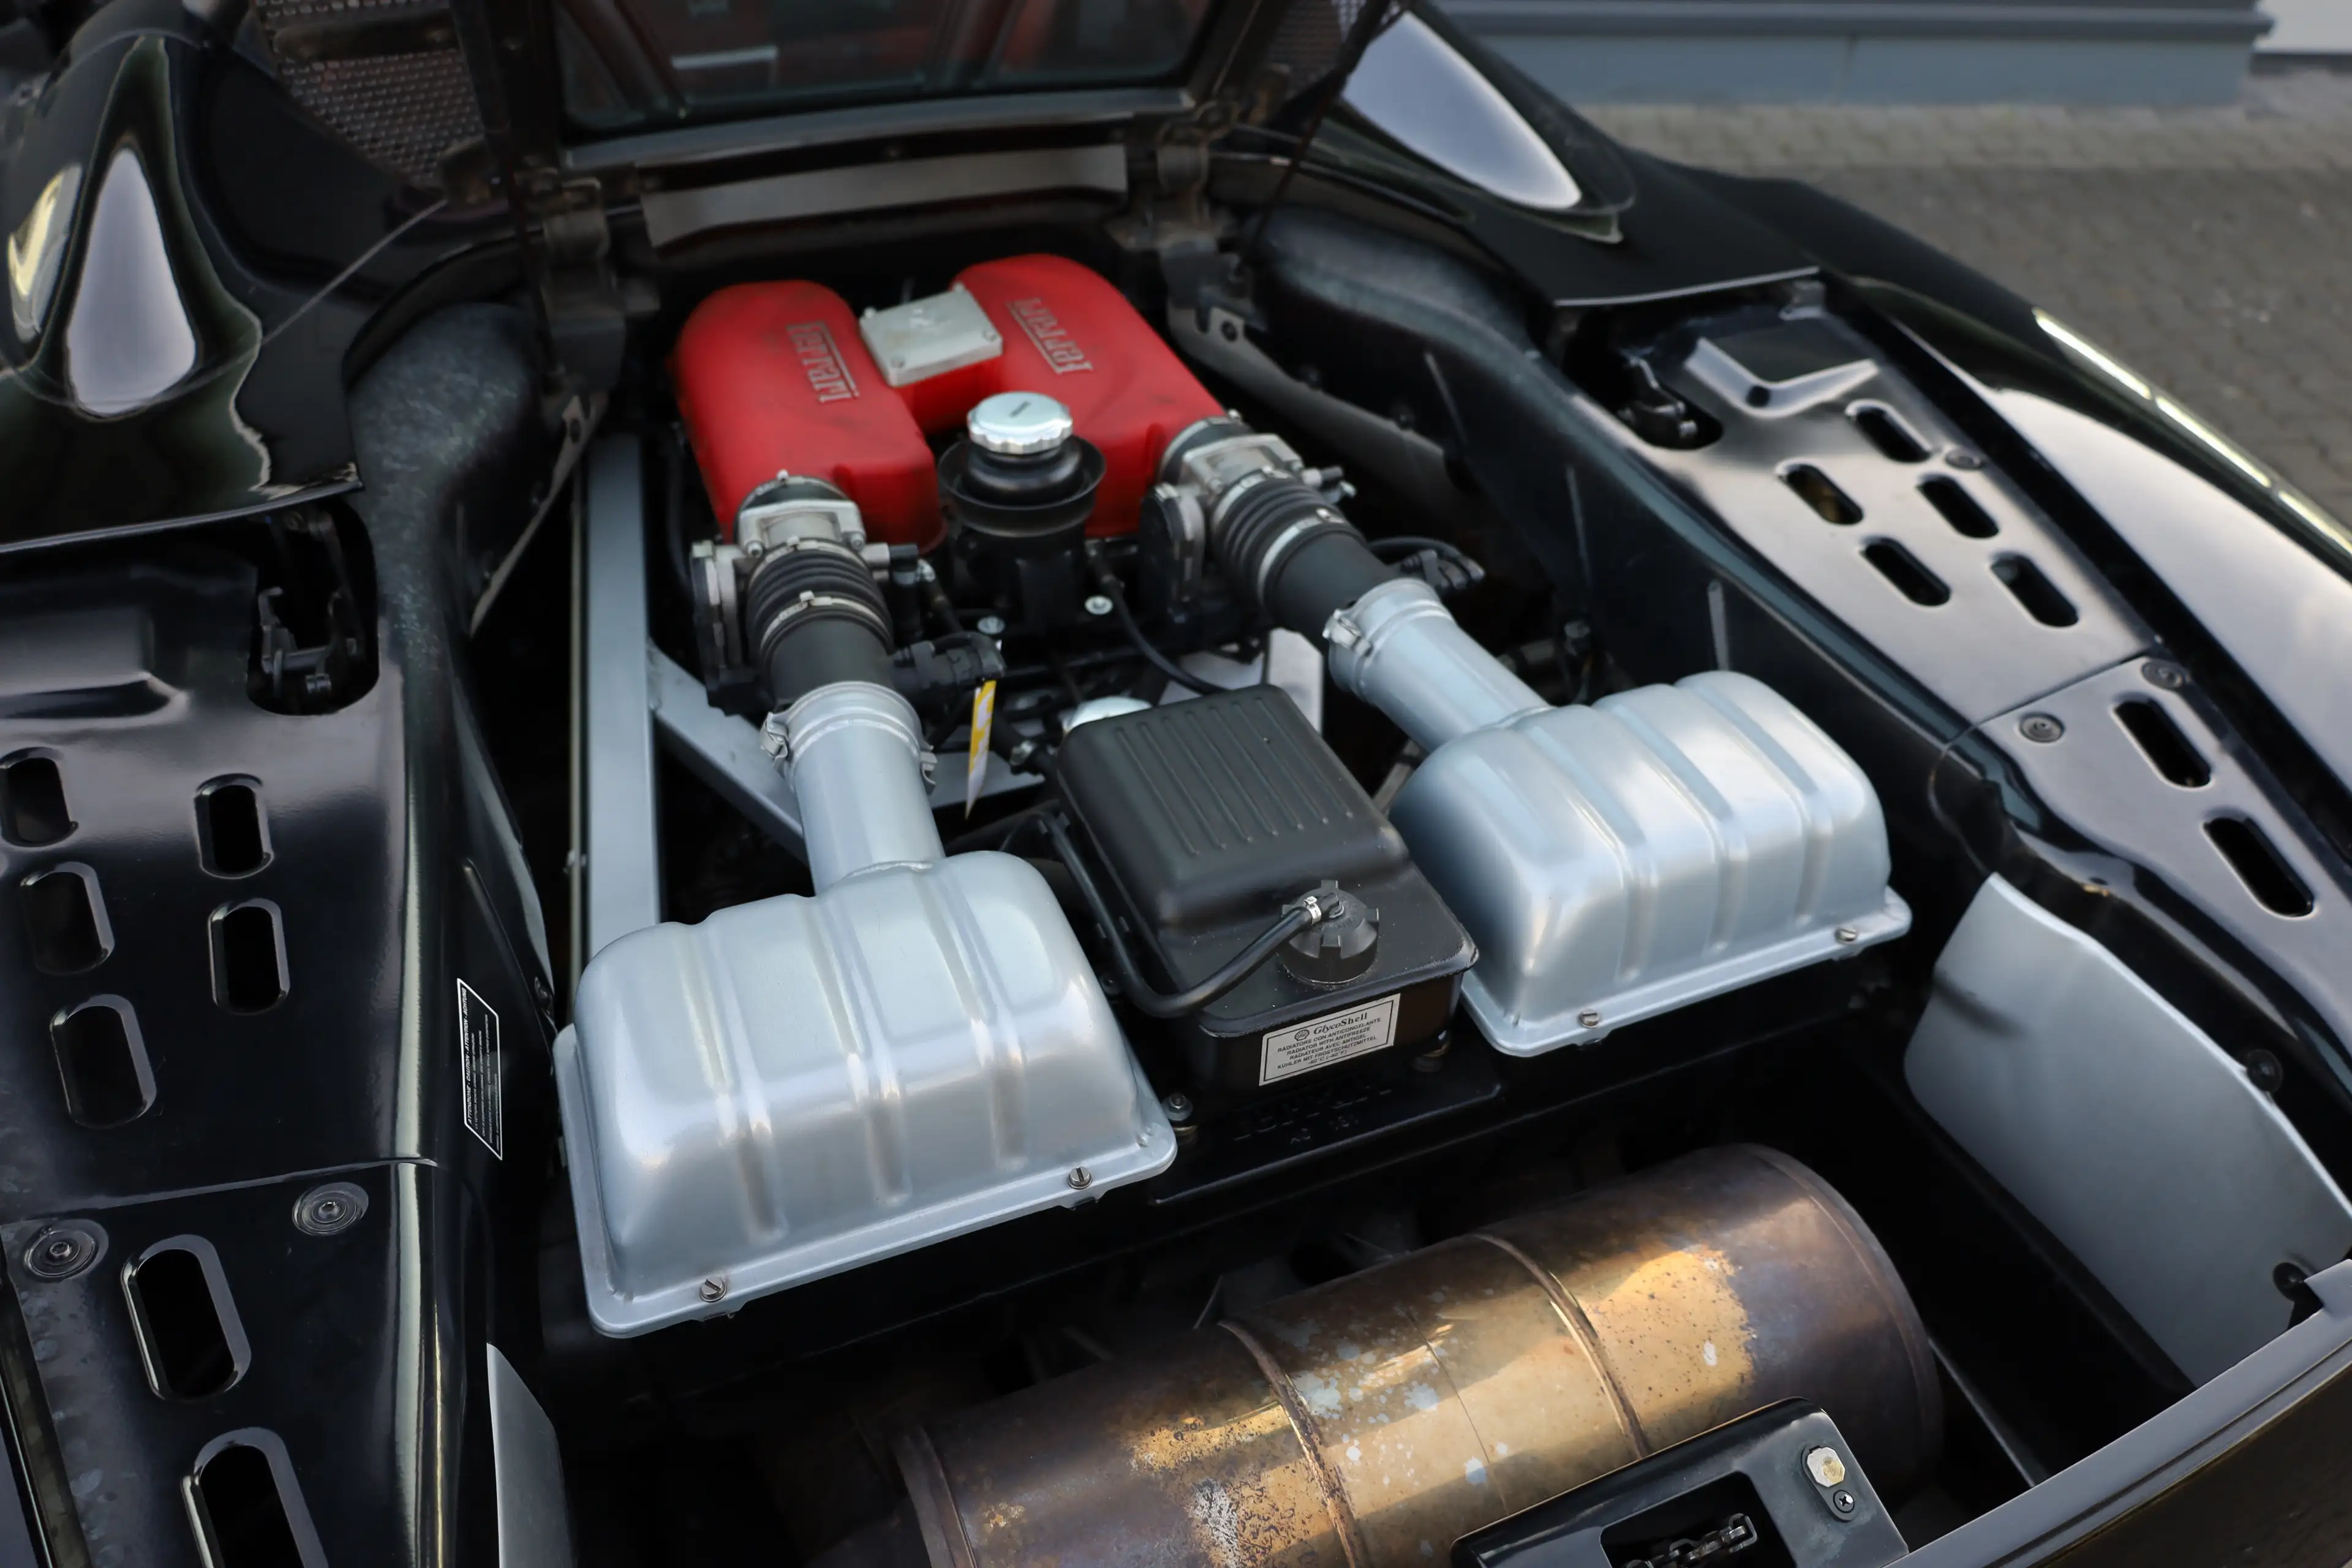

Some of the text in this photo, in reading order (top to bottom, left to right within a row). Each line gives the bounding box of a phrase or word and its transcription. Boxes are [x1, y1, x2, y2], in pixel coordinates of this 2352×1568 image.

[1005, 298, 1094, 375] Ferrari
[785, 320, 860, 404] Ferrari
[1278, 1039, 1311, 1052] RADIATORE
[1328, 1017, 1381, 1037] ANTICONGELANTE
[1314, 1012, 1368, 1036] GlycoShell
[1287, 1042, 1317, 1055] RADIATOR
[1335, 1027, 1370, 1041] ANTIFREEZE
[1290, 1033, 1366, 1060] RADIATEUR AVEC ANTIGEL
[1314, 1035, 1377, 1058] FROSTSCHUTZMITTEL
